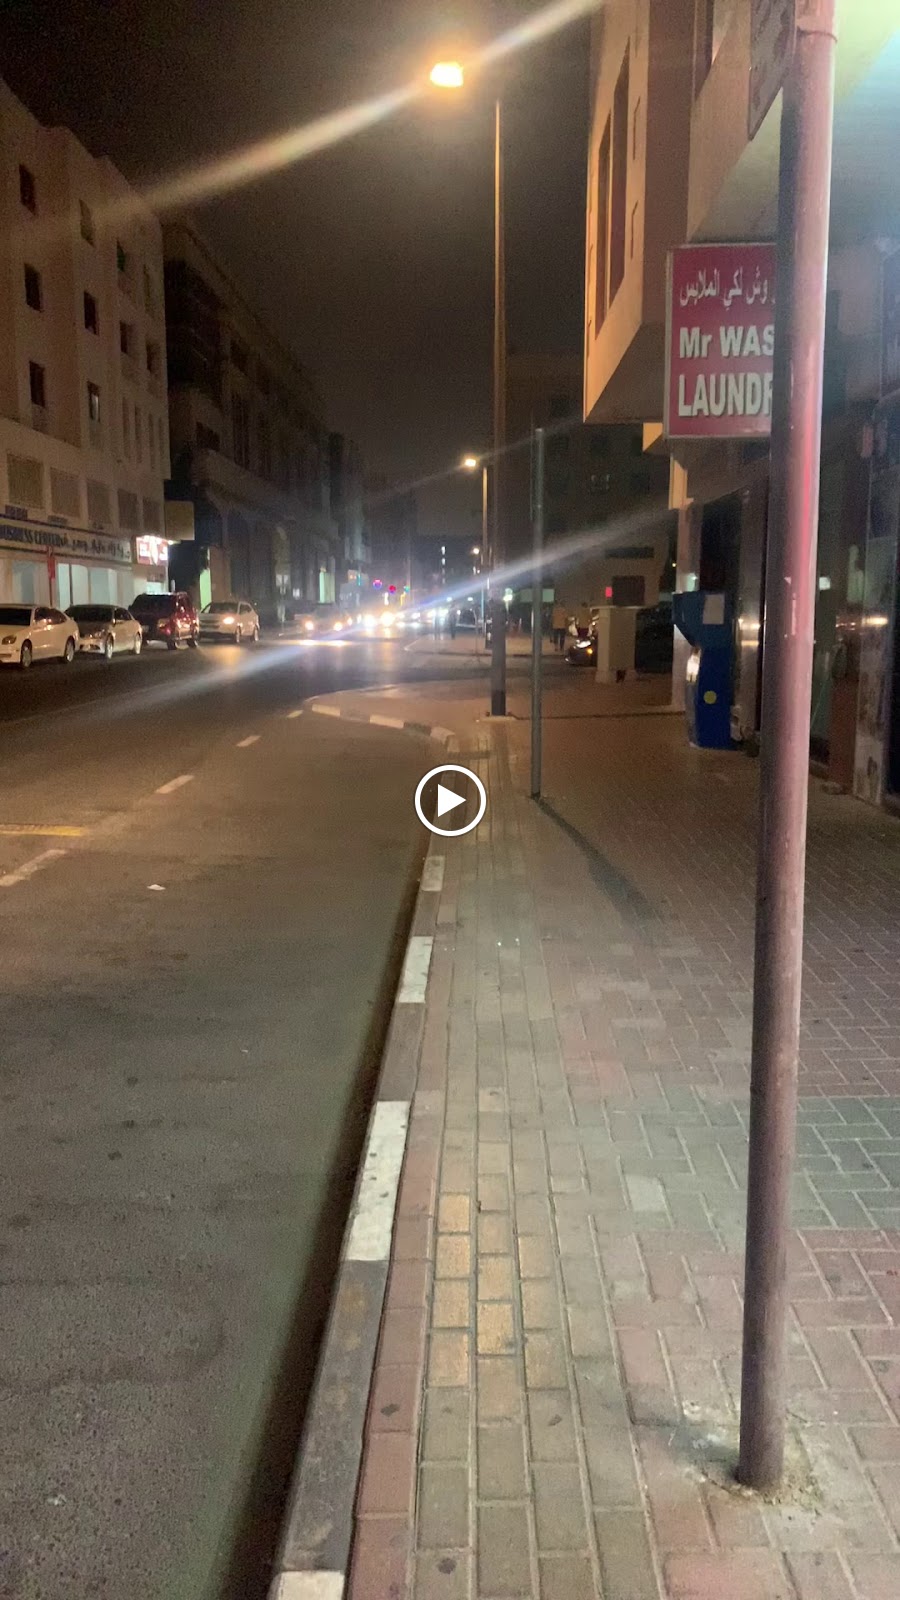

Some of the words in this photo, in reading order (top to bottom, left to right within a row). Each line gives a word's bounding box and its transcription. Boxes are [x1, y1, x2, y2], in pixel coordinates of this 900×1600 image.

[680, 267, 720, 306] الملابس
[679, 326, 712, 359] Mr
[719, 324, 774, 358] WAS
[678, 372, 773, 417] LAUNDR
